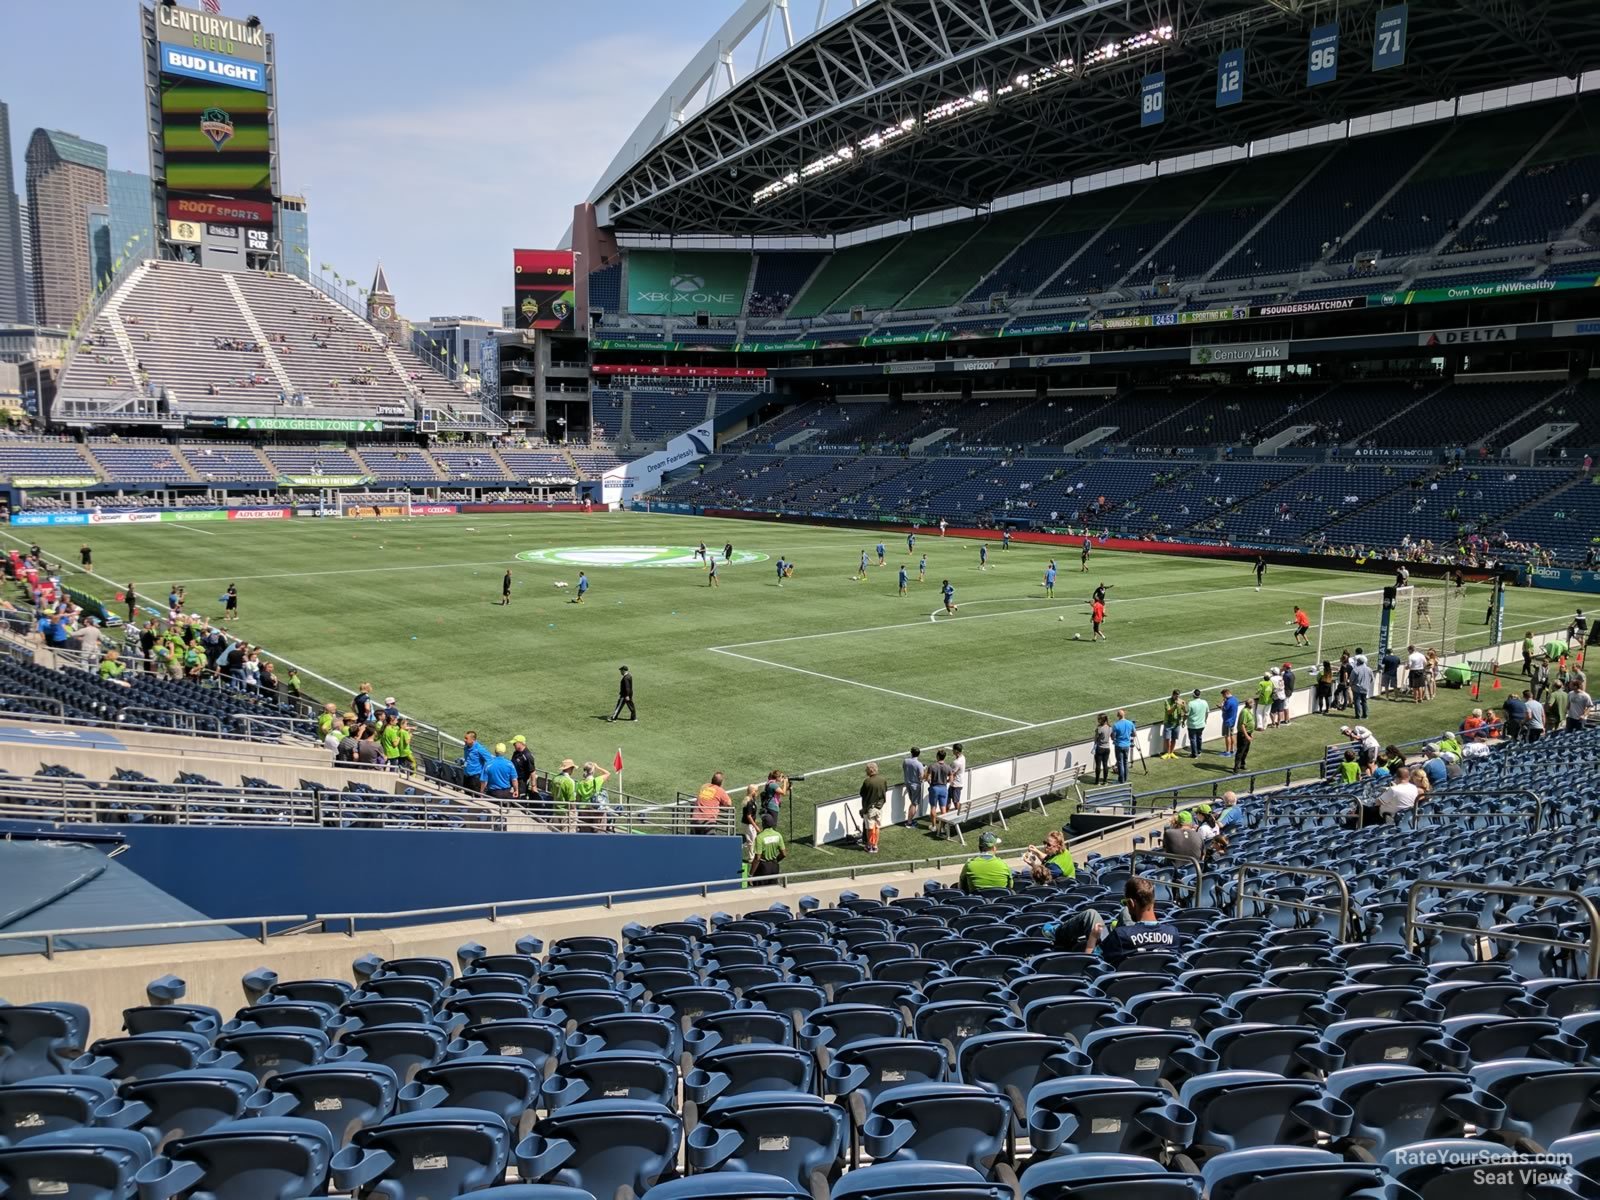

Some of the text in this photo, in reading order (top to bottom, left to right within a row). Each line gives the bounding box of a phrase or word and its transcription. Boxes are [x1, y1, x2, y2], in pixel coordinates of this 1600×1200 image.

[160, 5, 264, 47] CENTURYLINK
[193, 34, 234, 54] FIELD
[1378, 30, 1401, 56] 71
[1224, 60, 1238, 69] FAN
[1310, 46, 1335, 71] 96
[168, 52, 258, 82] BUD LIGHT
[1220, 70, 1240, 93] 12
[1143, 91, 1162, 114] 80
[178, 200, 215, 214] ROOT
[247, 230, 269, 241] Q13
[248, 240, 268, 250] FOX
[637, 290, 735, 303] XBOX ONE
[1447, 280, 1556, 298] Own Your #NWhealthy
[1260, 299, 1354, 316] #SOUNDERSMATCHDAY
[1106, 318, 1133, 328] SOUNDERS
[1144, 317, 1149, 326] 0
[1181, 310, 1229, 323] 0 SPORTING KC
[1446, 328, 1507, 343] DELTA
[1214, 346, 1280, 362] CenturyLink
[963, 360, 995, 371] verizon
[259, 419, 356, 431] XBOX GREEN ZONE
[647, 448, 695, 473] Dream Fearlessly
[235, 510, 283, 518] ADVOCARE
[1130, 931, 1174, 946] POSEIDON
